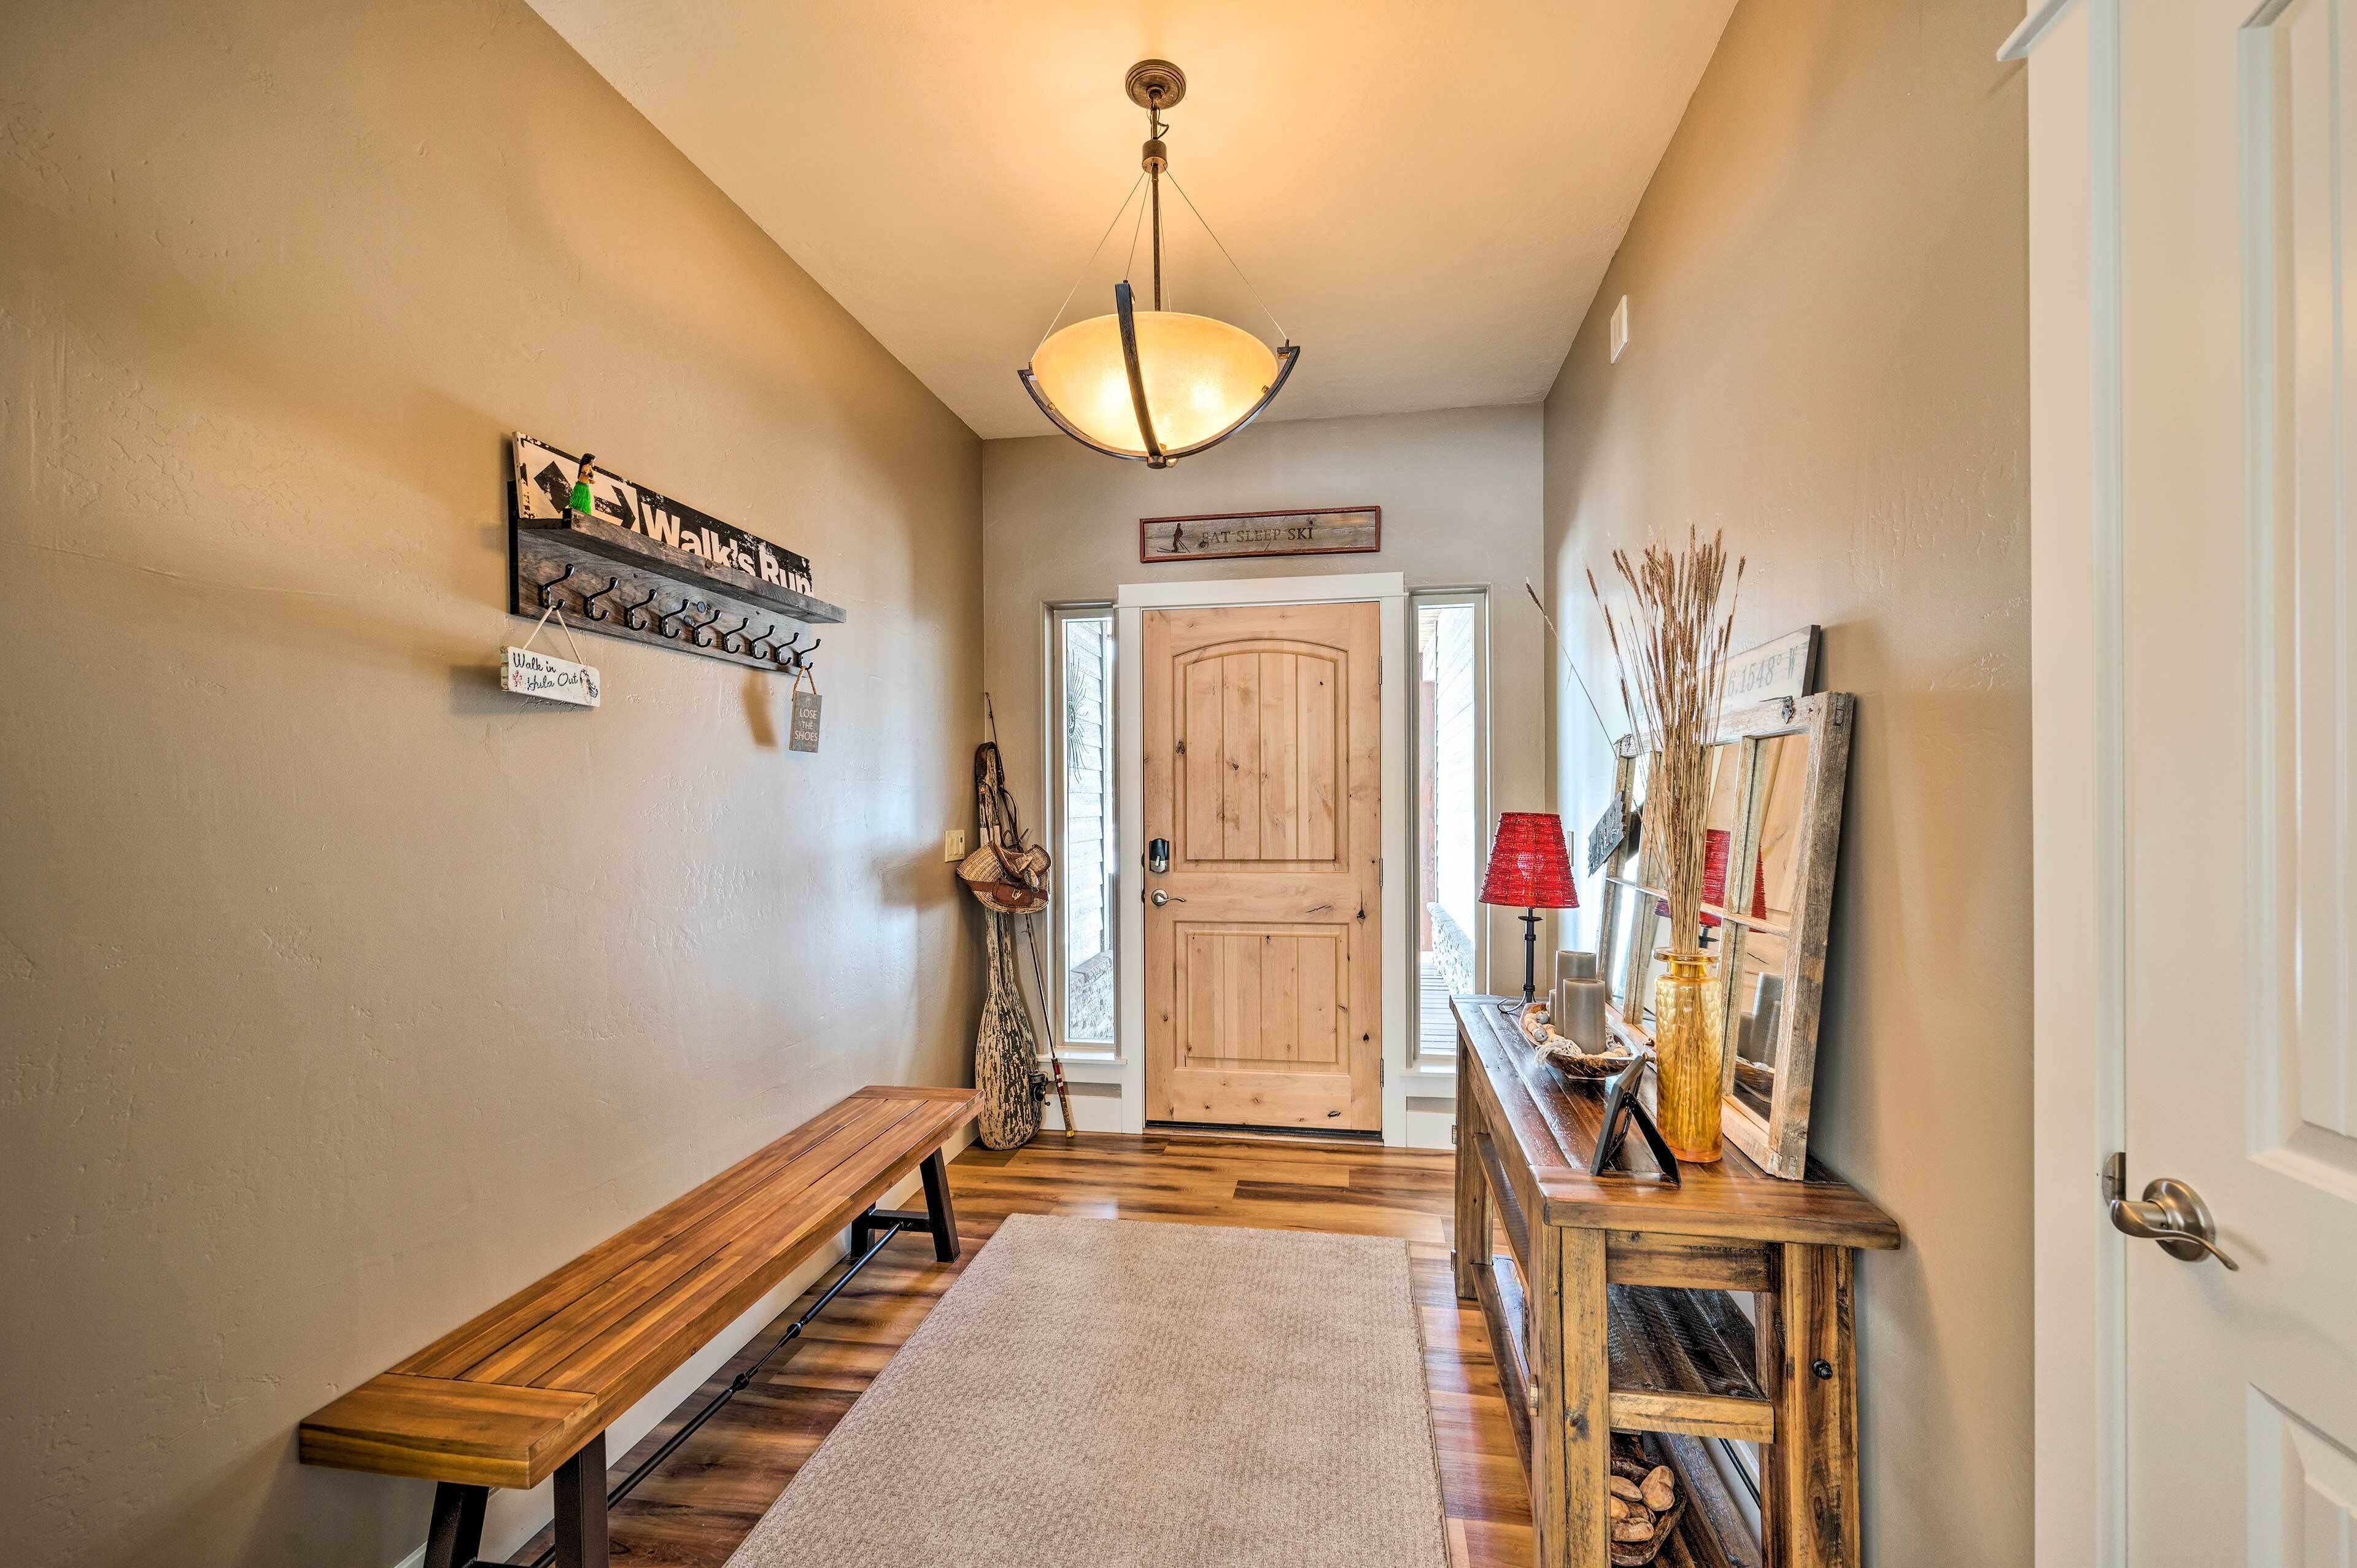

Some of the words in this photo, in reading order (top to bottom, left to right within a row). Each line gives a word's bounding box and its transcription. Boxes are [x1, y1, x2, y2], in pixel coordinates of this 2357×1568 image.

[1201, 531, 1231, 544] EAT
[1237, 529, 1281, 543] SLEEP
[1288, 527, 1314, 541] SKI
[641, 502, 756, 577] Walk's
[758, 548, 815, 598] Run
[513, 652, 543, 671] Walk
[546, 660, 556, 673] in
[1787, 646, 1799, 680] W
[527, 674, 555, 691] Hula
[557, 672, 579, 686] Out
[799, 708, 818, 719] LOSE
[801, 720, 815, 730] THE
[794, 730, 819, 742] SHOES
